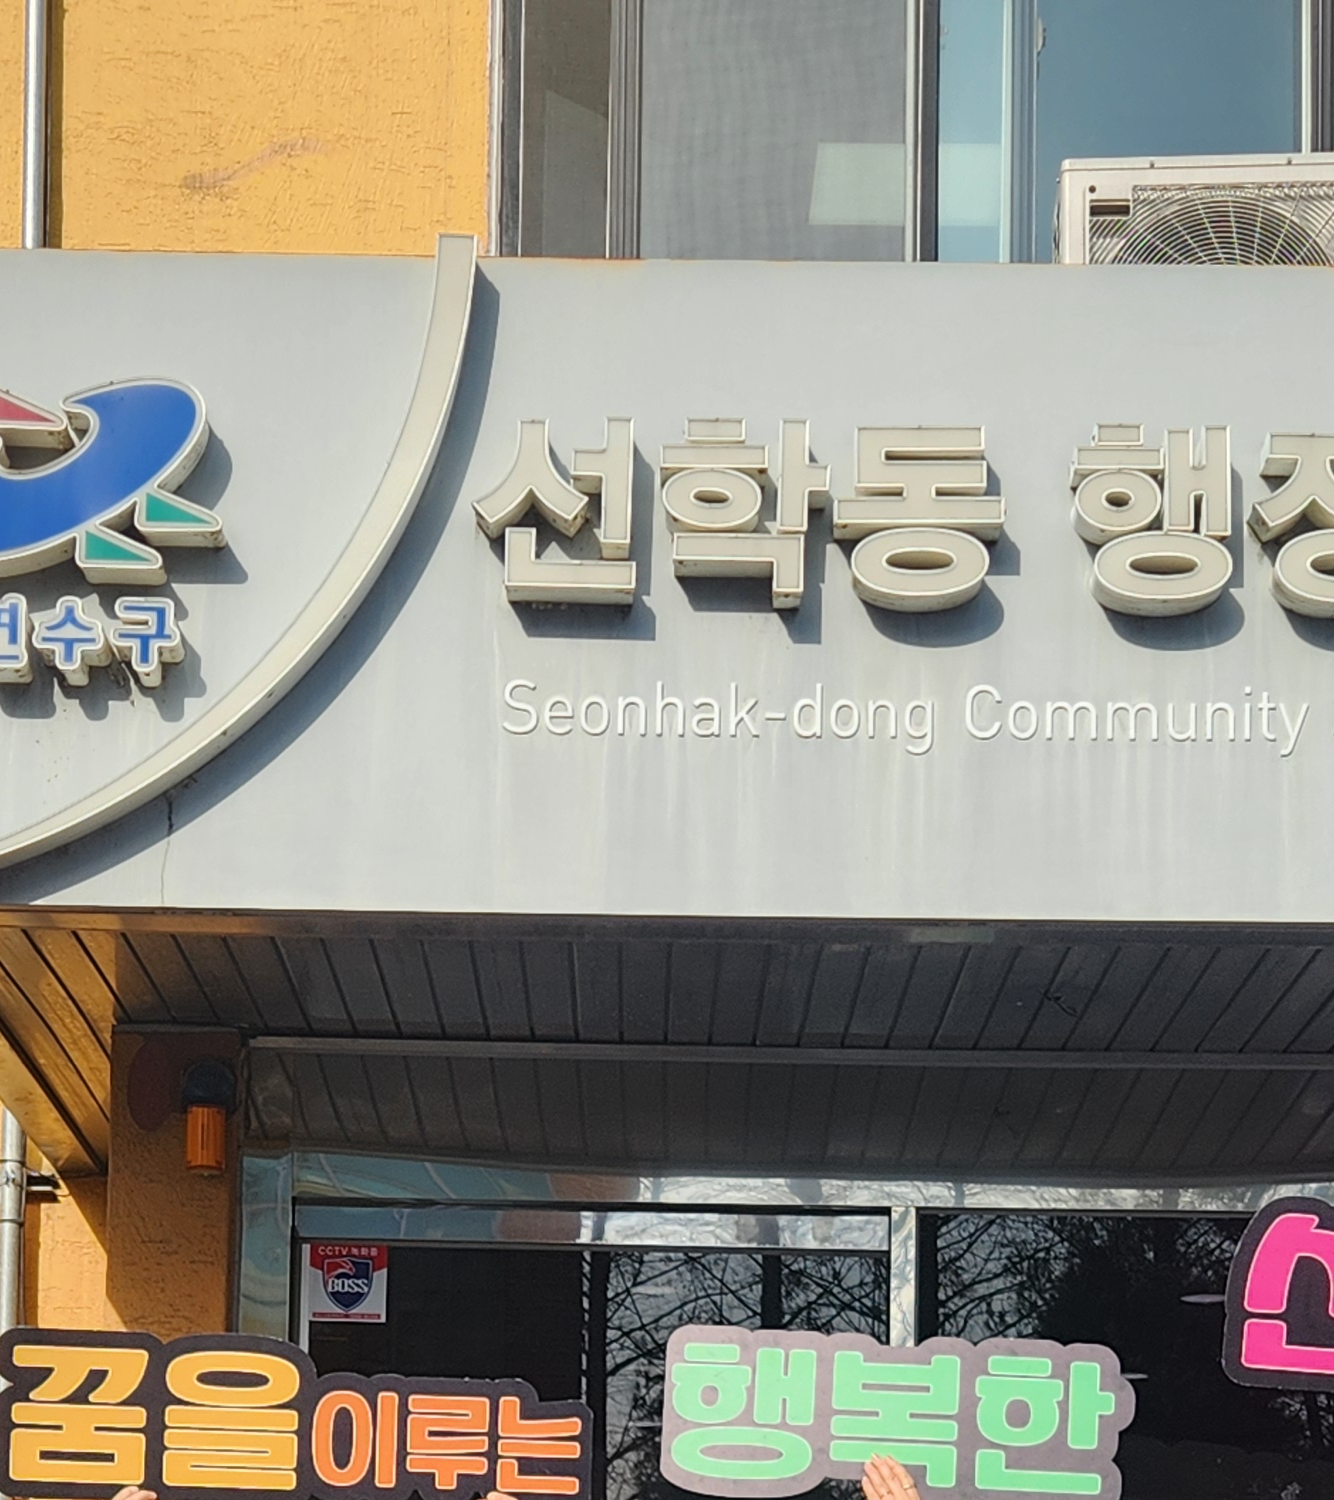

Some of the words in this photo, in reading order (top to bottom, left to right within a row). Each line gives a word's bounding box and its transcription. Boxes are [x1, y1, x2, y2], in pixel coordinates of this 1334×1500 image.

[472, 416, 1005, 612] 선학동
[503, 682, 934, 754] Seonhak-dong
[965, 685, 1310, 756] Community
[318, 1246, 348, 1255] CCTV
[328, 1278, 368, 1293] BOSS
[9, 1345, 300, 1489] 꿈을
[311, 1390, 582, 1493] 이루는
[671, 1342, 1115, 1495] 행복한
